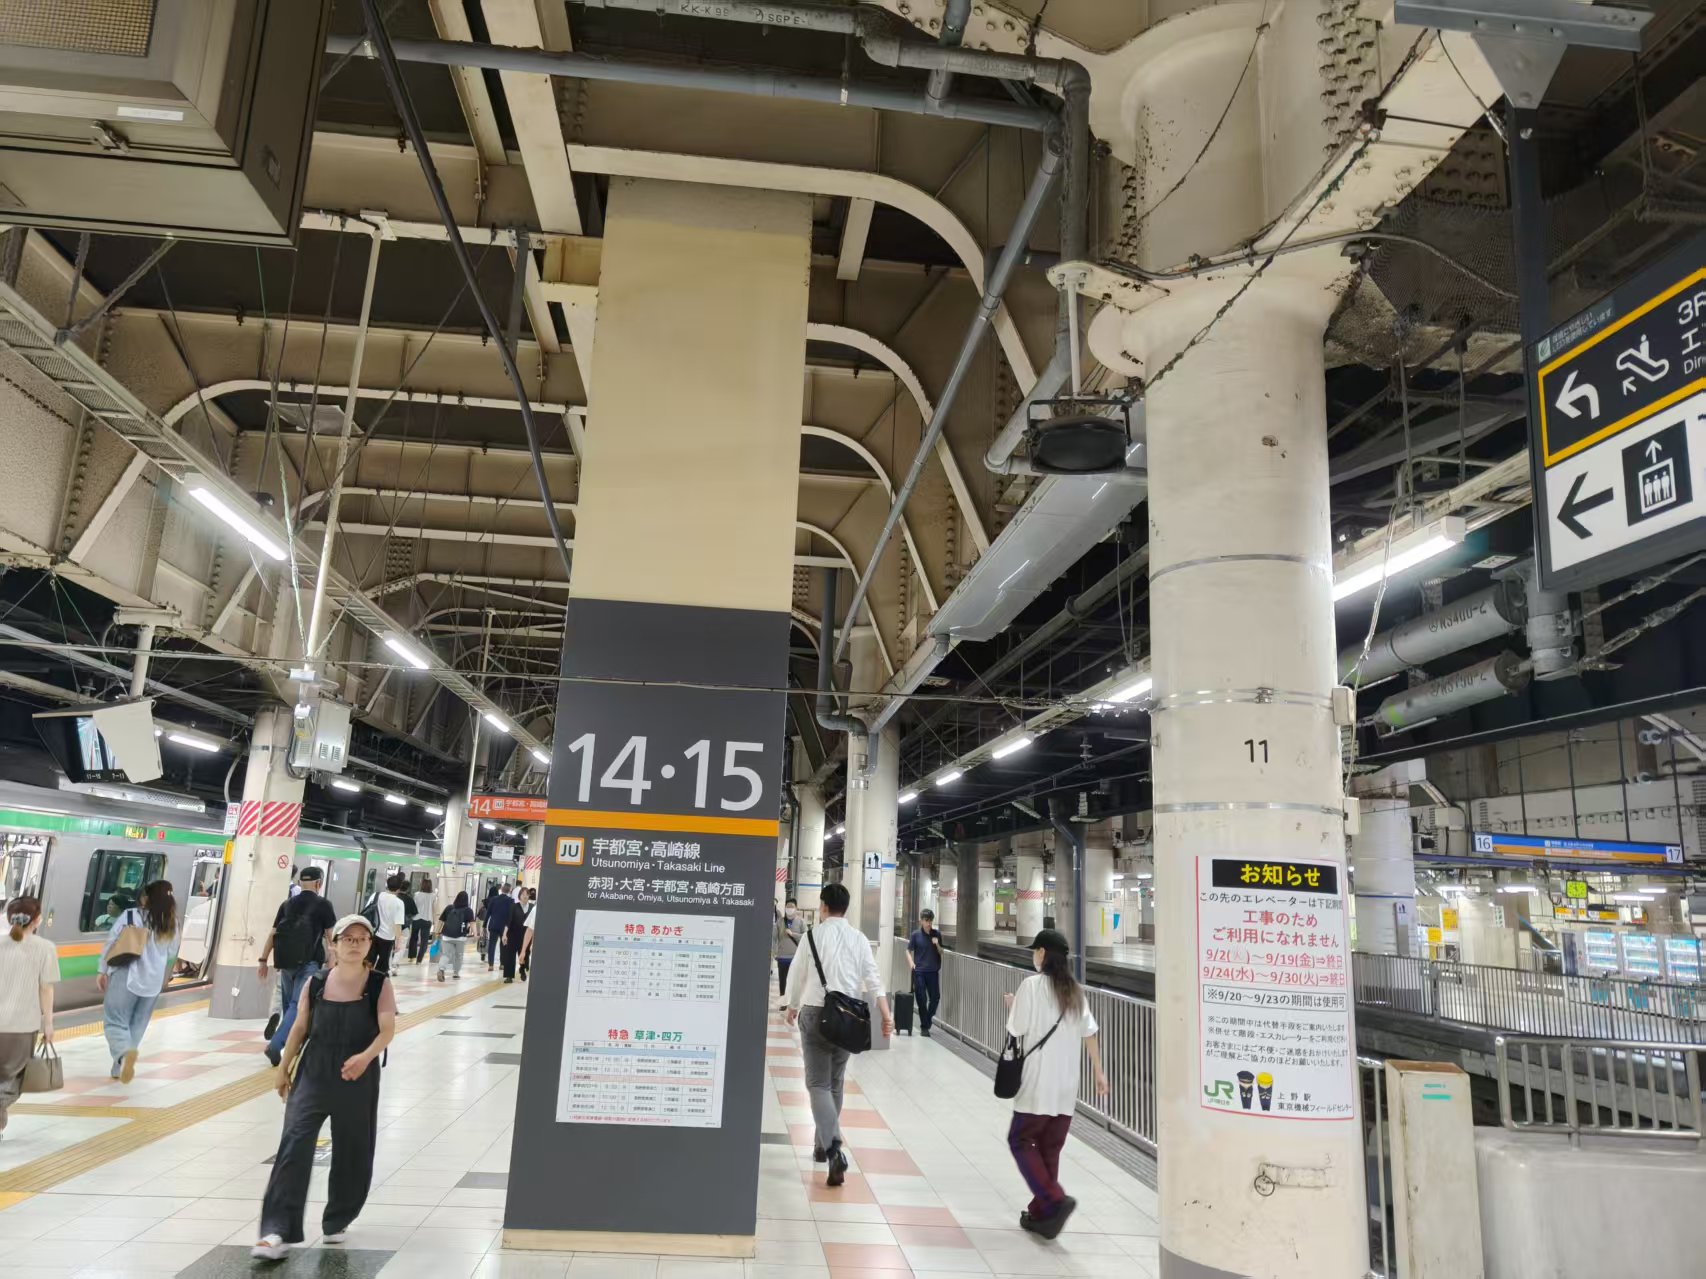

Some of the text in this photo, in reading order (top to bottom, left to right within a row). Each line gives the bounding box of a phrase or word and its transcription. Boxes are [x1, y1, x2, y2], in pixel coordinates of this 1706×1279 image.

[1244, 739, 1268, 763] 11
[472, 798, 491, 815] 14
[559, 843, 579, 858] JU
[592, 838, 701, 860] 宇都宮・高崎線
[1476, 836, 1491, 850] 16
[1668, 848, 1680, 861] 17
[704, 862, 726, 873] Line
[1240, 863, 1321, 887] お知らせ
[588, 876, 746, 896] 赤羽・大宮・宇都宮・高崎方面
[587, 891, 598, 899] for
[599, 891, 635, 901] Akabane,
[666, 895, 711, 906] Utsunomiya
[712, 897, 718, 905] &
[721, 897, 755, 907] Takasaki
[1243, 910, 1318, 928] 工事のため
[624, 923, 684, 936] 特急 あかぎ
[1213, 927, 1339, 948] ご利用になれません
[607, 1028, 683, 1043] 特急 草津・四万
[1204, 1079, 1235, 1099] JR
